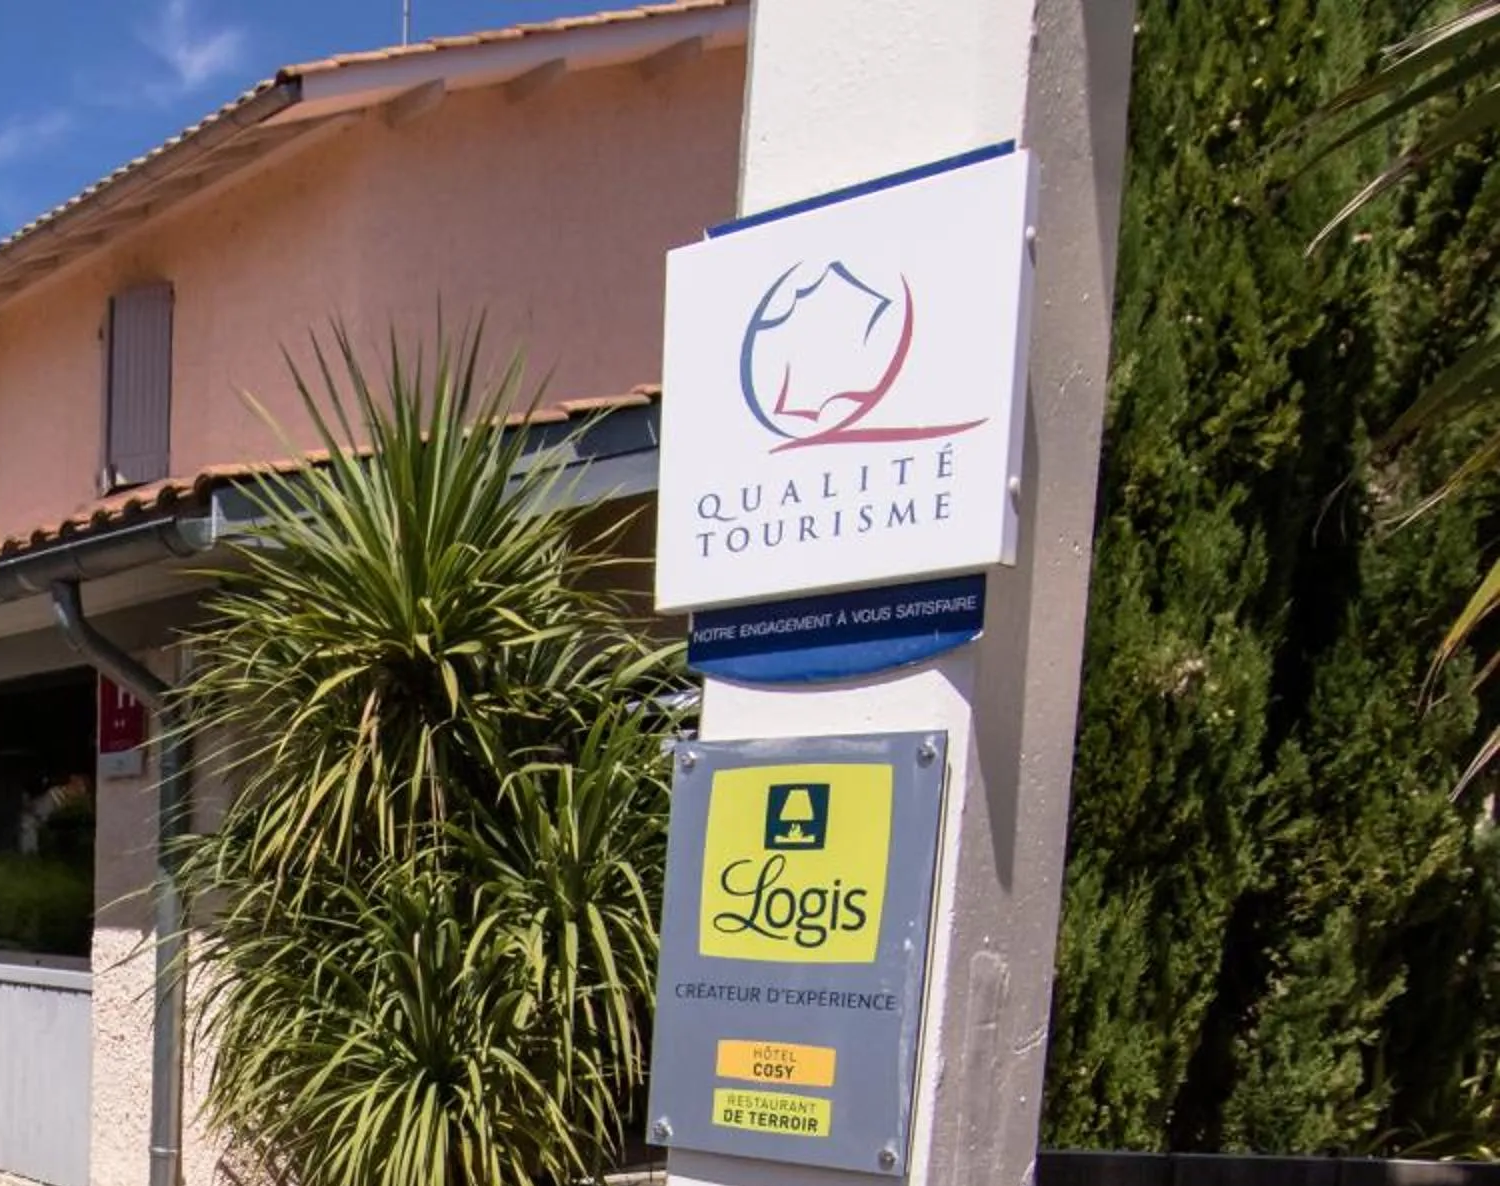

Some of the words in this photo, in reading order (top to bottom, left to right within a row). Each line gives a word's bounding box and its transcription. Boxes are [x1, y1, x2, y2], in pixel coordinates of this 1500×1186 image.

[697, 443, 954, 522] QUALITÉ
[696, 491, 952, 557] TOURISME
[693, 624, 736, 644] NOTRE
[739, 613, 833, 639] ENGAGEMENT
[836, 609, 848, 626] À
[850, 606, 893, 625] VOUS
[895, 594, 978, 620] SATISFAIRE
[713, 854, 868, 948] Logis
[752, 1062, 795, 1080] COSY
[753, 1045, 797, 1063] HÔTEL
[723, 1108, 744, 1125] DE
[748, 1110, 819, 1133] TERROIR
[726, 1094, 817, 1115] RESTAURANT
